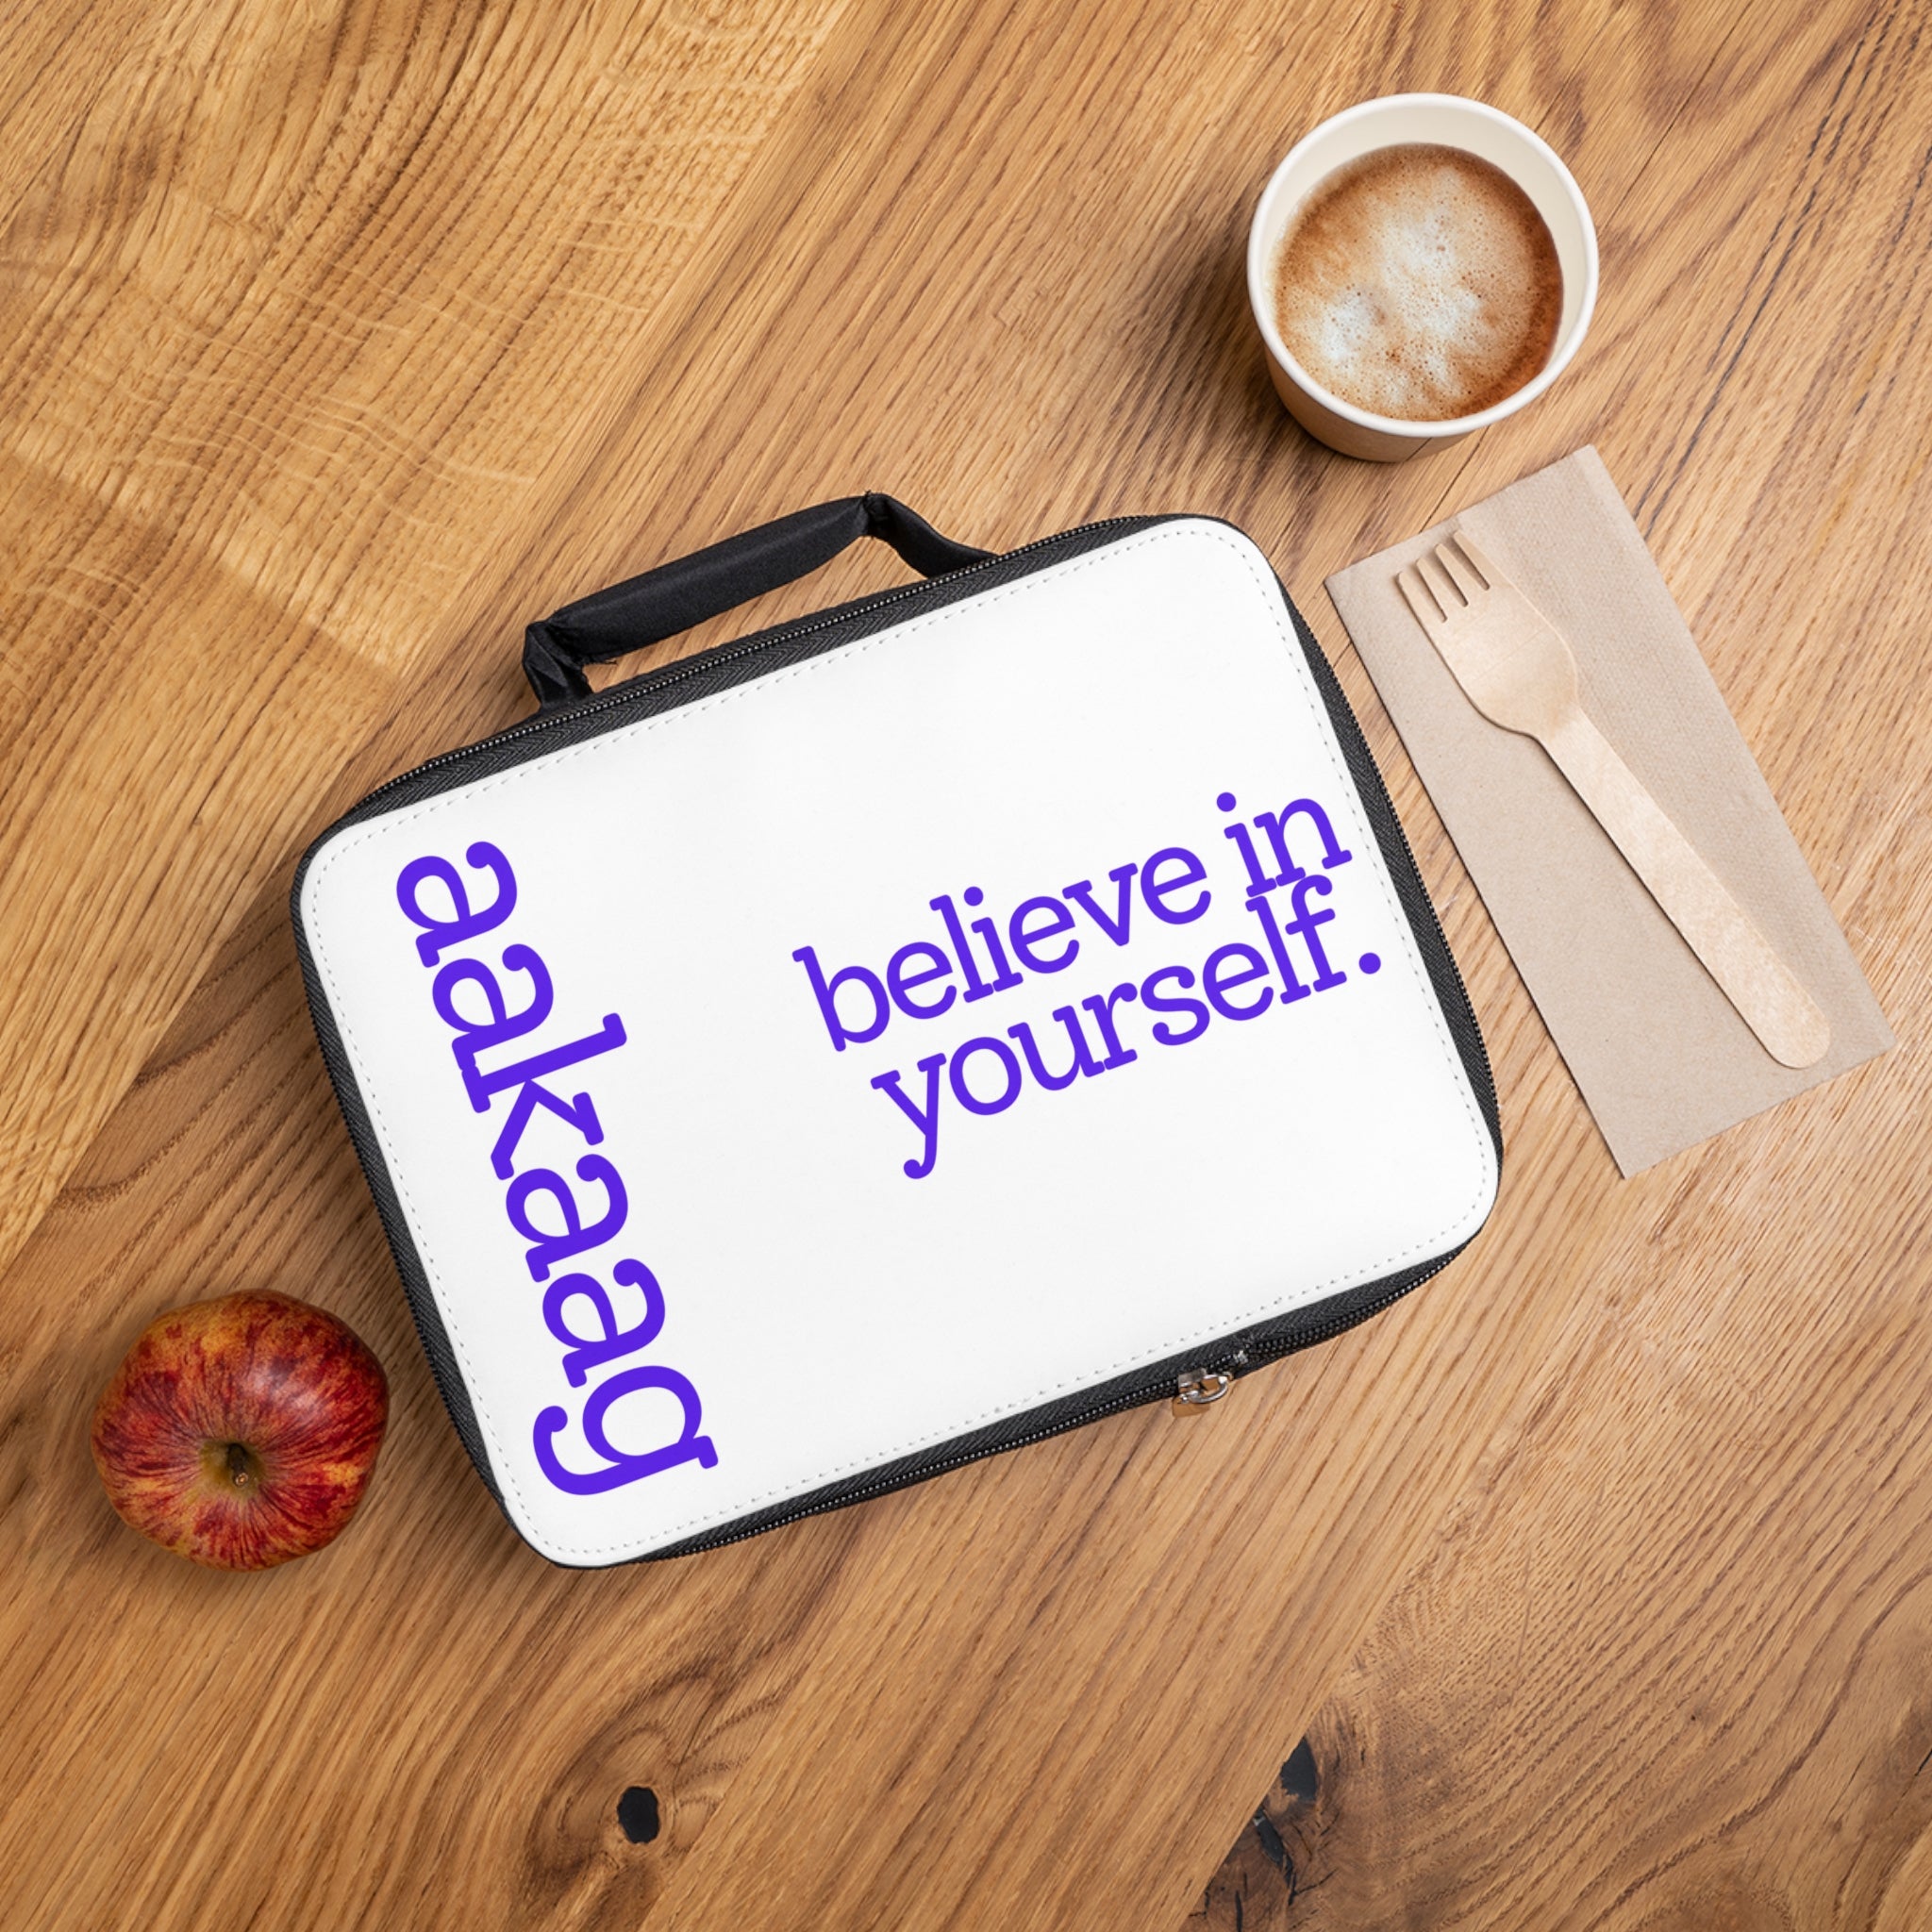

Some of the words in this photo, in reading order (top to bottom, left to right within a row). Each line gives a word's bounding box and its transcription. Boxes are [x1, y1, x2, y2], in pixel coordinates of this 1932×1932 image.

[791, 847, 1212, 1053] believe
[1216, 792, 1353, 898] in
[870, 874, 1382, 1180] yourself.
[396, 841, 720, 1496] aakaag
